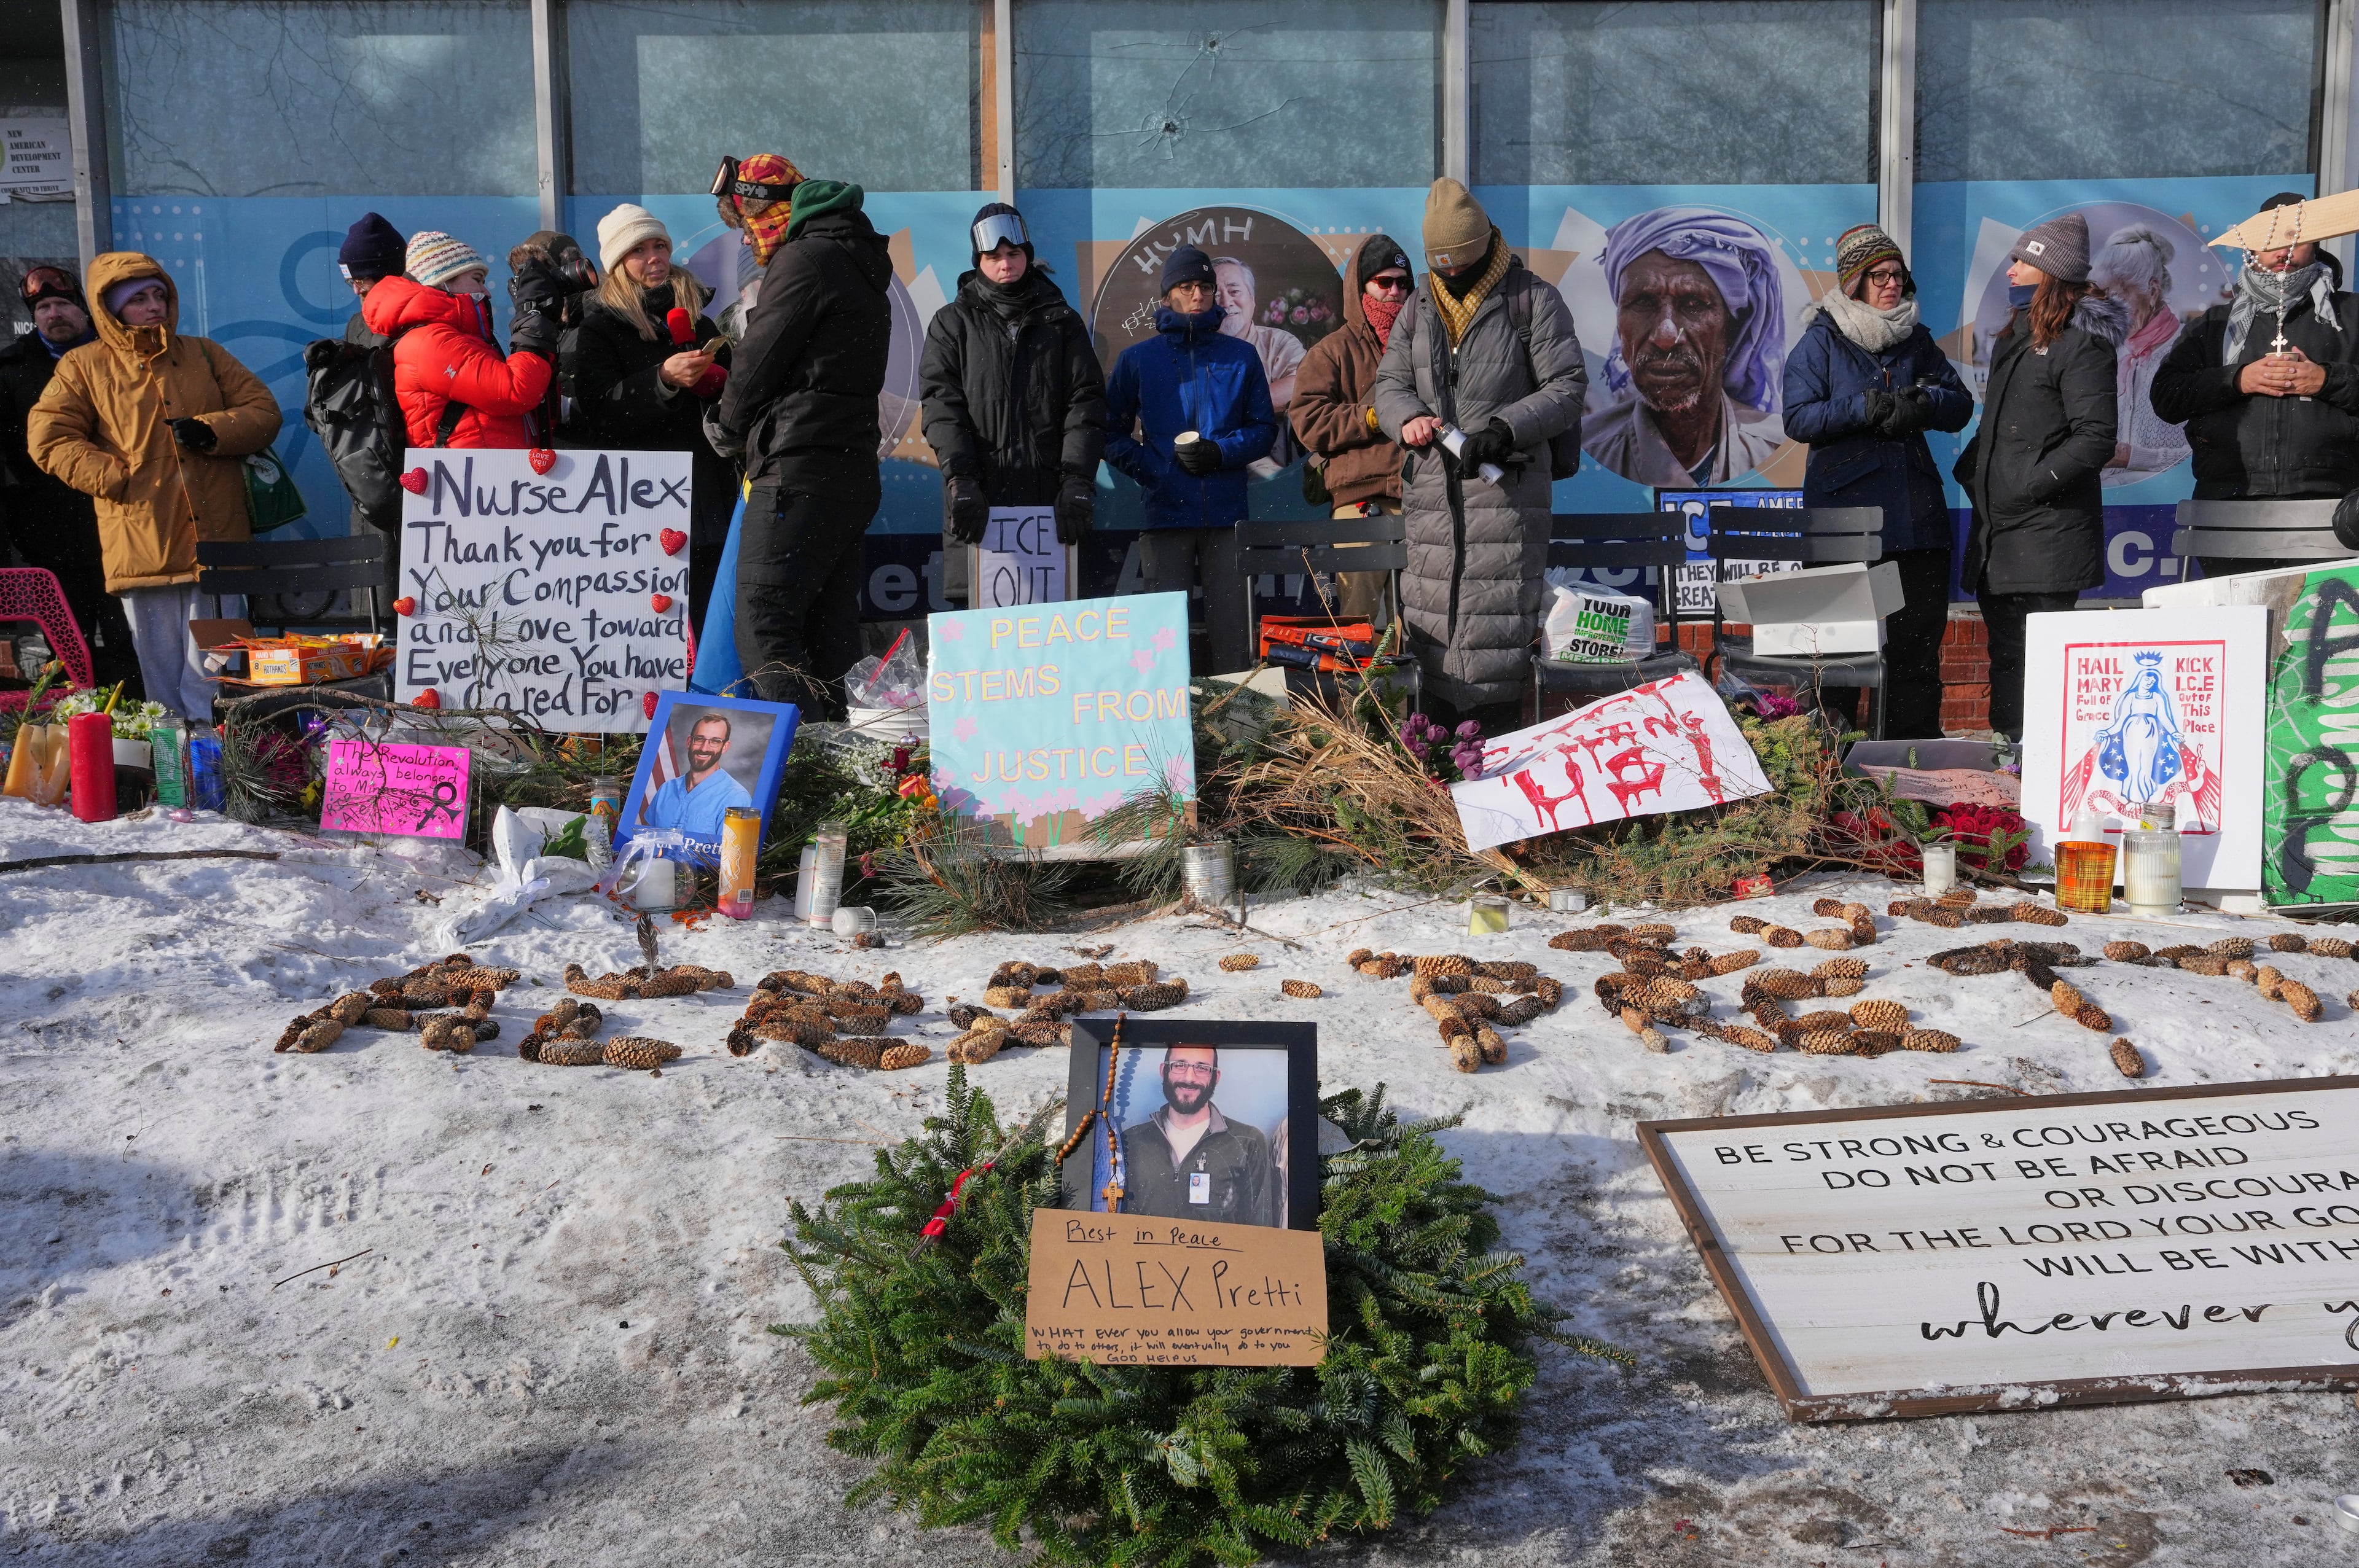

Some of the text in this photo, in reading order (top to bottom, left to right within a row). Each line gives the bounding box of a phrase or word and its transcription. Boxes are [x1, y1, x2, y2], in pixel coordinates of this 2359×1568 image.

[9, 141, 46, 150] AMERICAN
[10, 152, 61, 162] DEVELOPMENT
[12, 165, 40, 174] CENTER
[433, 456, 574, 517] Nurse
[407, 521, 651, 572] Thank you for
[992, 516, 1052, 556] ICE
[1676, 564, 1716, 582] THEY
[409, 566, 689, 614] Your Compassion
[993, 566, 1056, 606] OUT
[1583, 598, 1631, 618] YOUR
[410, 604, 685, 644] and Love toward
[991, 607, 1130, 649] PEACE
[1576, 611, 1630, 636] HOME
[1575, 628, 1626, 644] IMPROVEMENT
[329, 646, 350, 654] WARMERS
[264, 664, 287, 674] HOTHANDS
[307, 661, 326, 670] HOTHANDS
[407, 644, 685, 689] Everyone You have
[2078, 658, 2124, 675] HAIL
[2176, 657, 2214, 673] KICK
[931, 664, 1062, 702] STEMS
[2078, 677, 2124, 693] MARY
[464, 673, 633, 716] Cared For
[1073, 687, 1187, 724] FROM
[2076, 695, 2096, 706] Full
[2076, 709, 2110, 721] Grace
[2181, 703, 2210, 717] This
[2183, 719, 2215, 733] Place
[335, 743, 454, 767] The Revolution
[971, 744, 1149, 783] JUSTICE
[332, 778, 346, 792] to
[334, 763, 457, 789] always belonged
[681, 837, 723, 856] Prett
[1715, 1110, 2320, 1164] BE STRONG & COURAGEOUS
[1822, 1147, 2248, 1189] DO NOT BE AFRAID
[2045, 1188, 2115, 1209] OR
[1066, 1220, 1221, 1246] Rest in Peace
[1780, 1233, 1881, 1254] FOR
[1889, 1228, 1991, 1251] THE
[1999, 1220, 2132, 1245] LORD
[2140, 1211, 2286, 1236] YOUR
[2023, 1239, 2359, 1277] WILL BE WITH
[1063, 1258, 1302, 1311] ALEX Pretti
[1921, 1281, 2272, 1341] wherever
[1031, 1327, 1084, 1338] WHAT
[1136, 1327, 1159, 1340] you
[1168, 1327, 1200, 1336] allow
[1207, 1327, 1234, 1340] your
[1240, 1327, 1312, 1339] government
[1037, 1340, 1050, 1350] to
[1058, 1340, 1070, 1350] do
[1075, 1341, 1085, 1350] to
[1130, 1342, 1143, 1352] it
[1146, 1340, 1165, 1350] will
[1172, 1341, 1229, 1356] eventually
[1238, 1341, 1248, 1350] do
[1254, 1340, 1265, 1350] to
[1270, 1342, 1291, 1351] you
[1107, 1353, 1137, 1362] GOD
